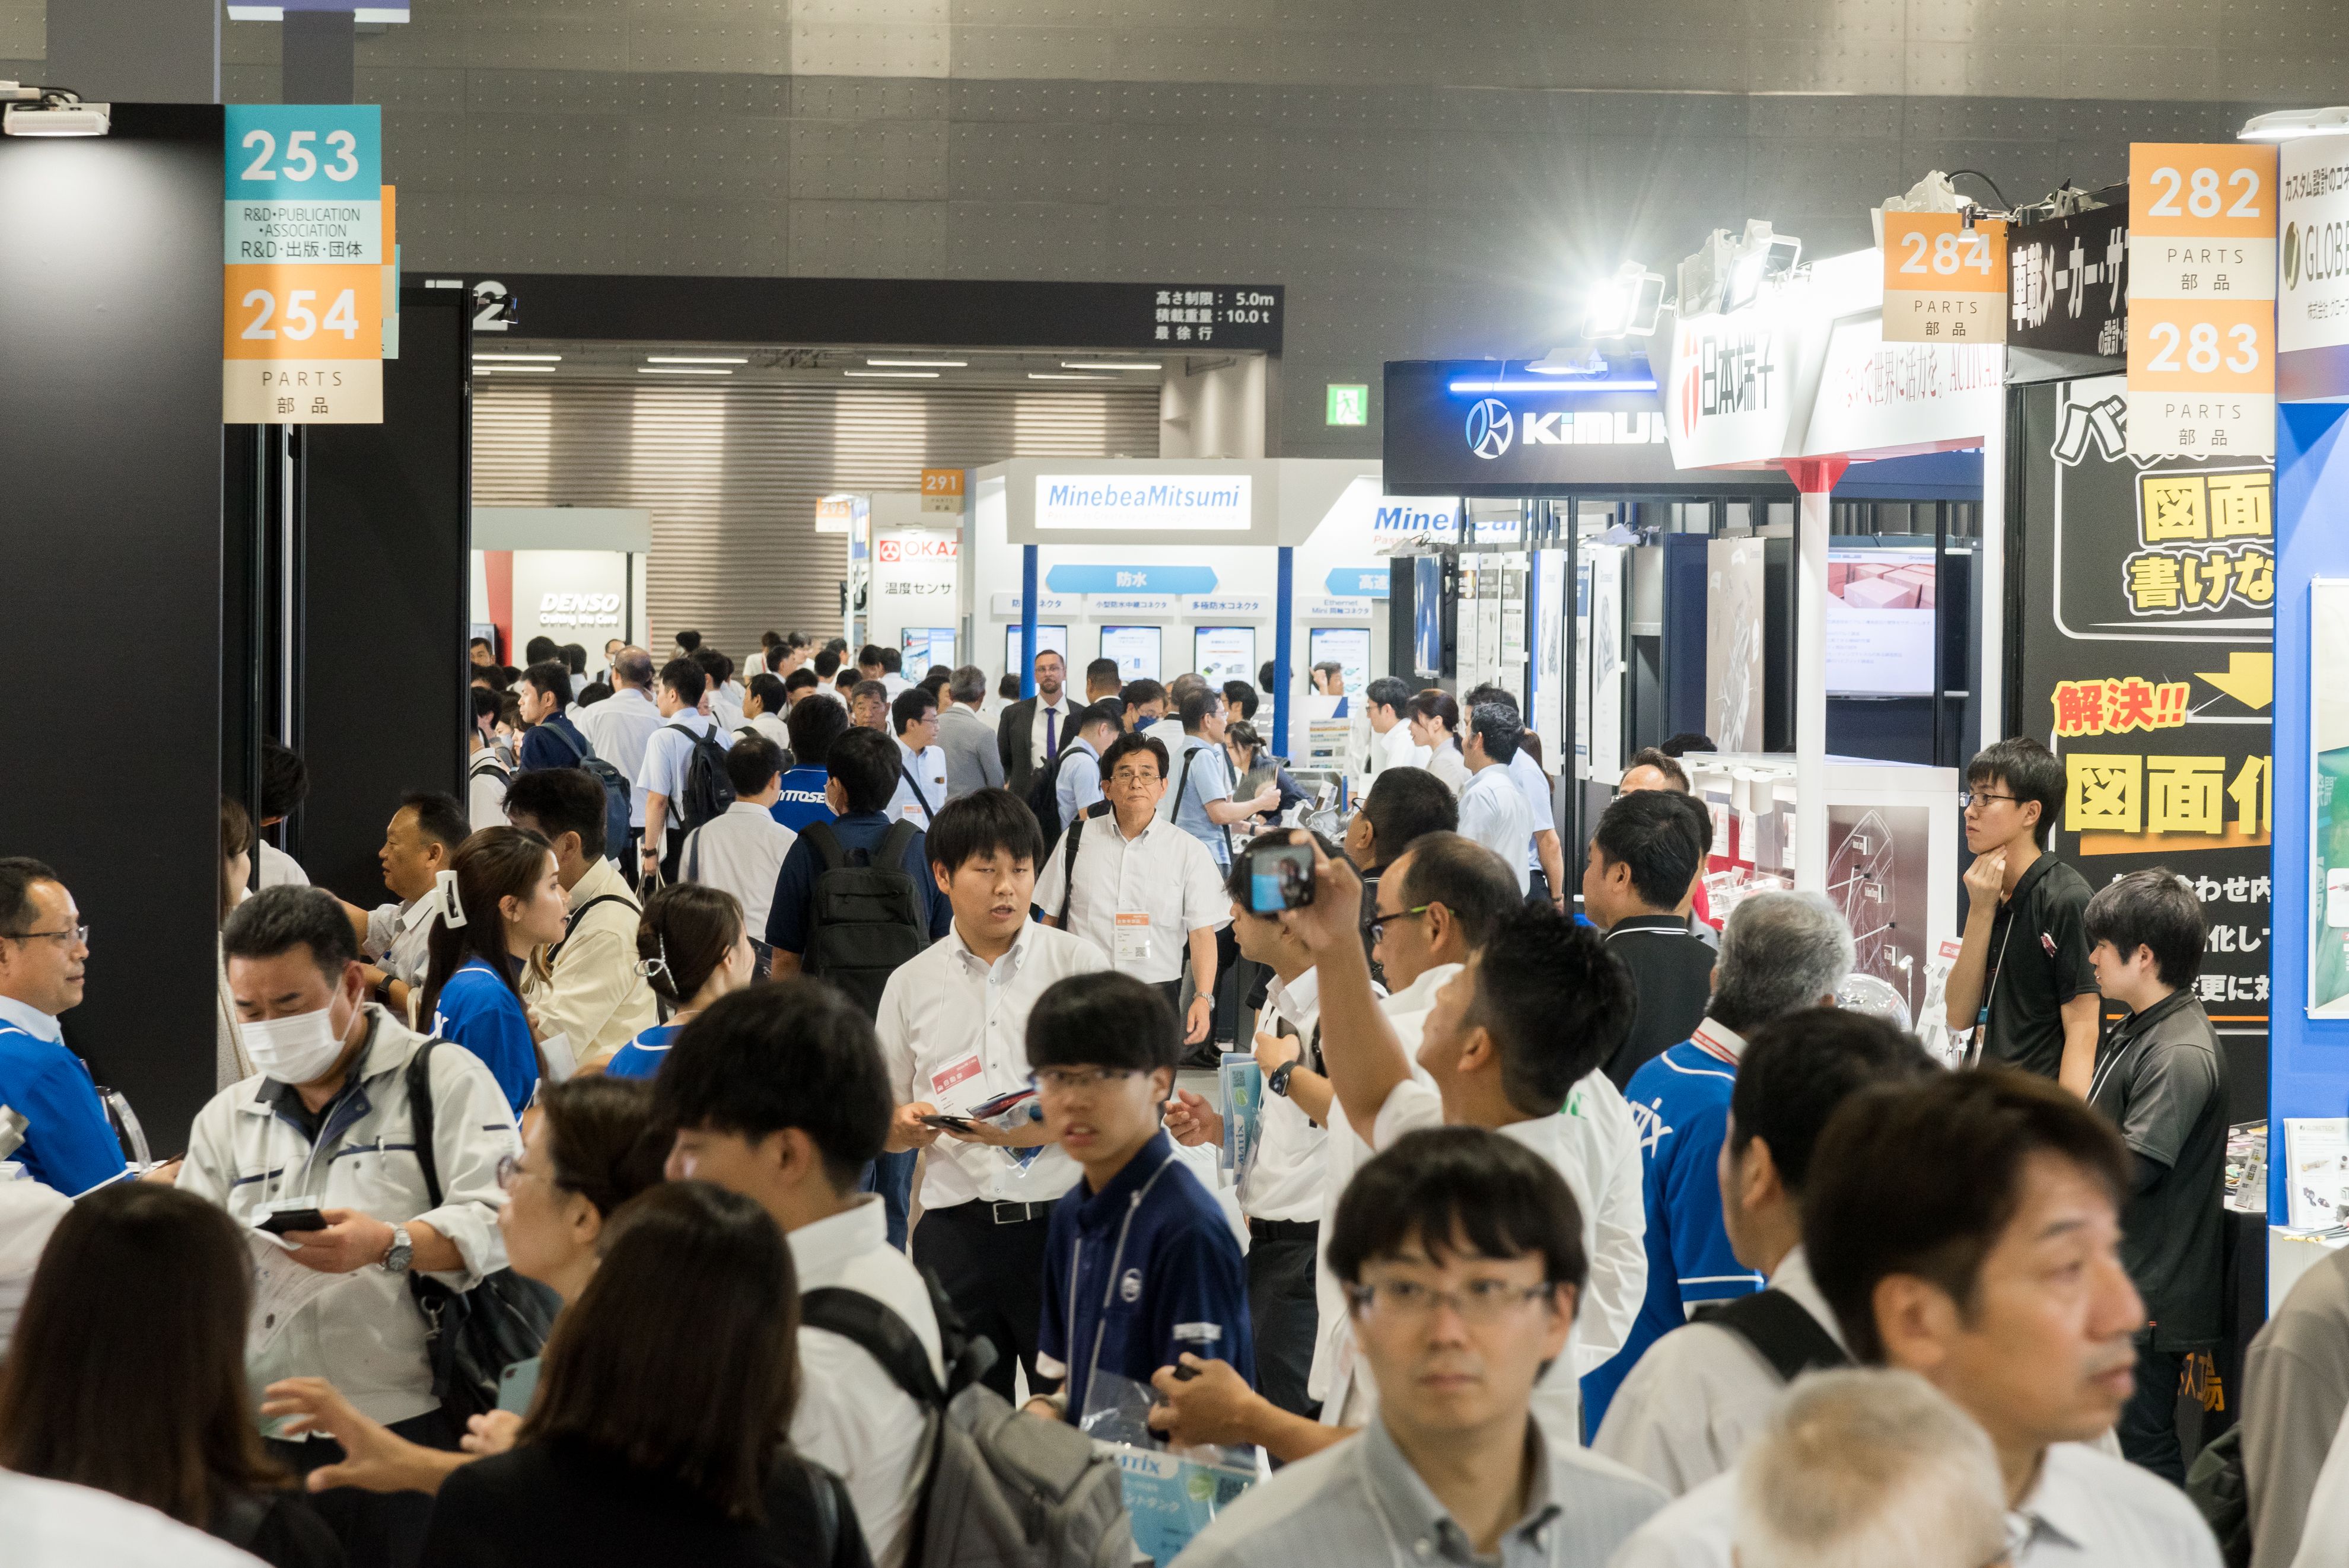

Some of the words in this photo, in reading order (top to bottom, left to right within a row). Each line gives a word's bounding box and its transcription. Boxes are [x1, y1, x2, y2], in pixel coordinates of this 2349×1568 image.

[241, 130, 359, 182] 253
[2147, 167, 2261, 218] 282
[1899, 232, 1993, 276] 284
[2167, 248, 2245, 264] PARTS
[2012, 227, 2129, 331] 車載メーカー・サ
[2181, 273, 2230, 291] 部品
[1236, 292, 1275, 306] 5.0m
[1914, 299, 1978, 314] PARTS
[241, 289, 359, 340] 254
[1925, 321, 1966, 337] 部品
[2146, 321, 2260, 374] 283
[262, 371, 343, 388] PARTS
[276, 396, 331, 416] 部品
[2166, 404, 2242, 420] PARTS
[2178, 428, 2229, 447] 部品
[926, 475, 957, 490] 291
[1049, 484, 1240, 506] MinebeaMitsumi
[821, 503, 846, 515] 295
[1116, 571, 1147, 588] 防水
[885, 582, 954, 595] 温度センサ
[540, 592, 620, 612] DENSO
[1012, 598, 1062, 609] 防ネクタ
